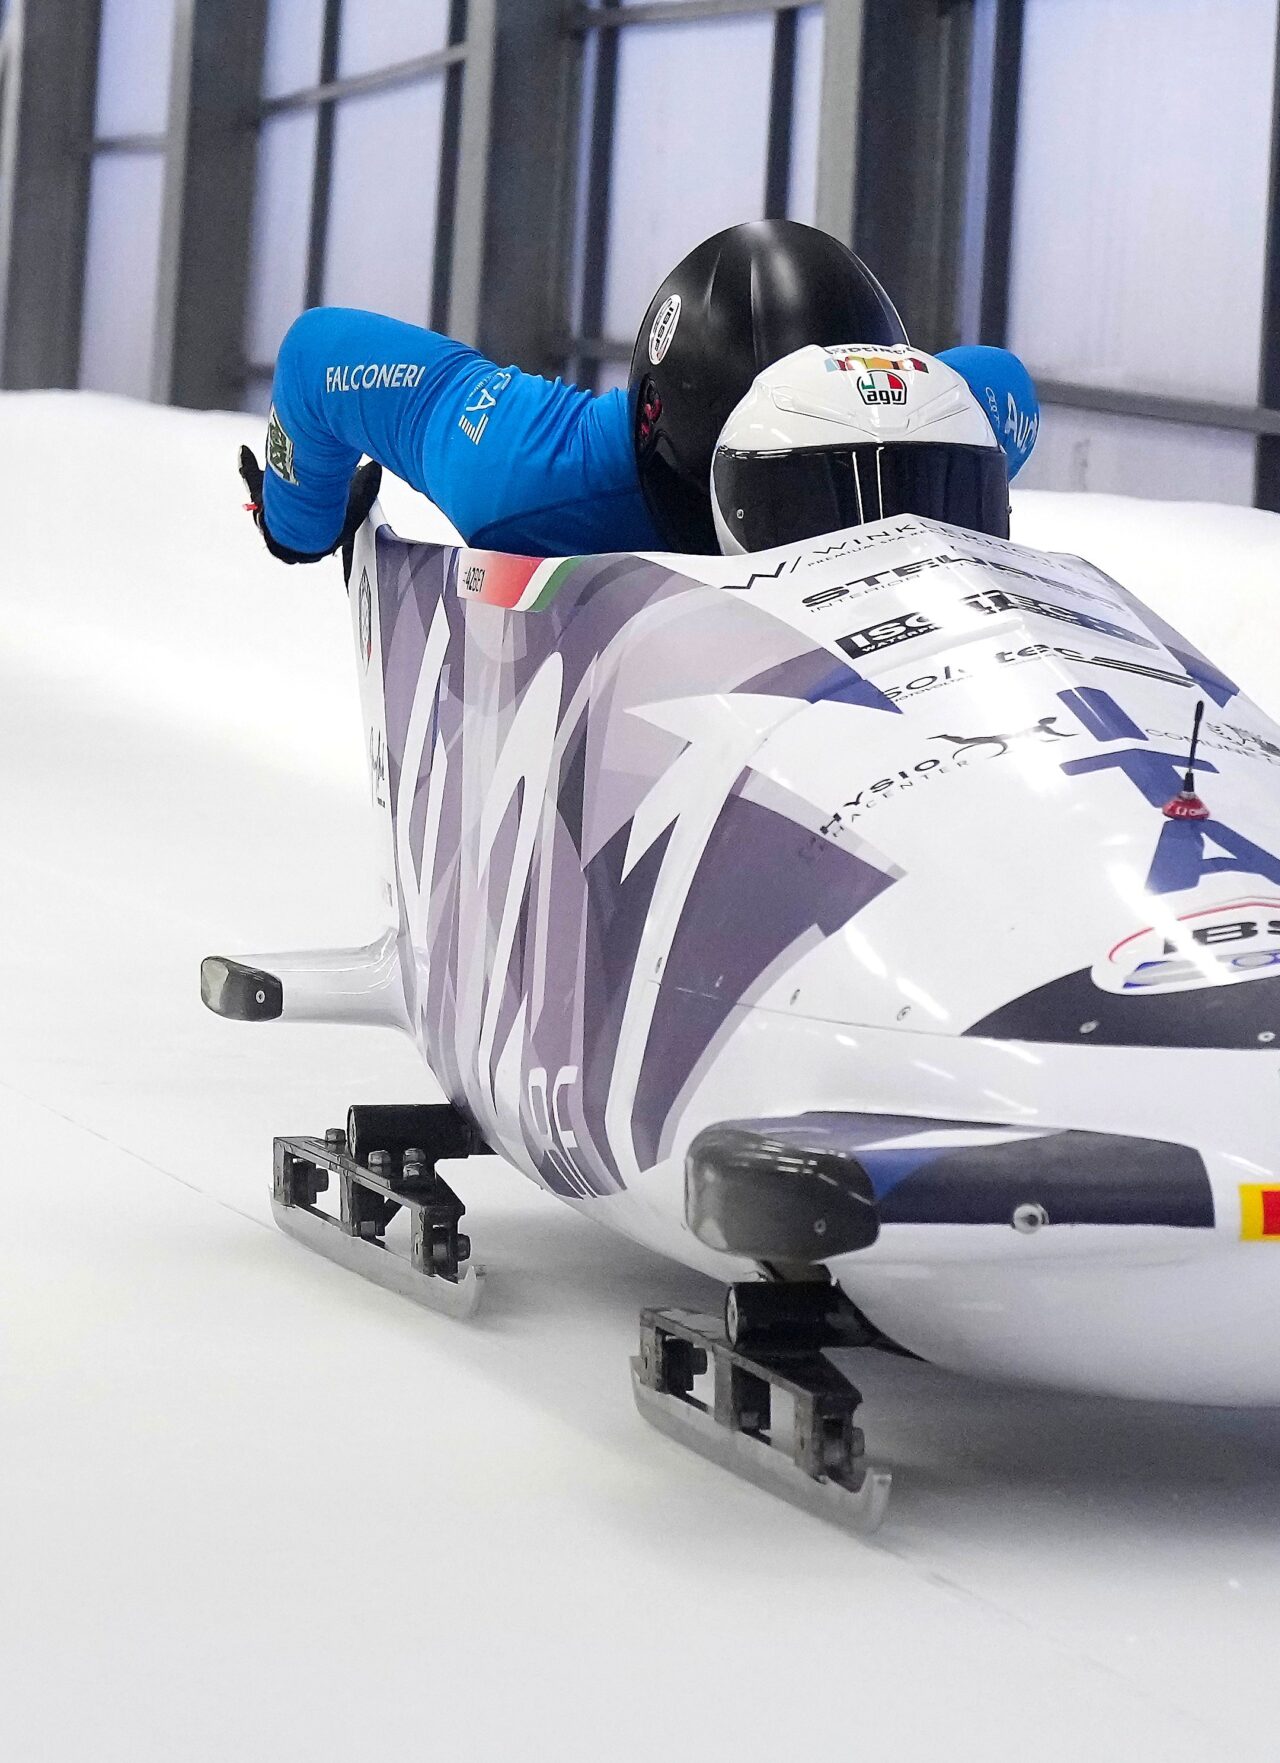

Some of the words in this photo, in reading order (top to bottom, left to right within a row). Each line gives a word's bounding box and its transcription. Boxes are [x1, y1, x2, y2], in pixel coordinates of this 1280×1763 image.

[326, 363, 426, 394] FALCONERI
[866, 390, 902, 405] agv
[811, 759, 940, 845] HYSIO
